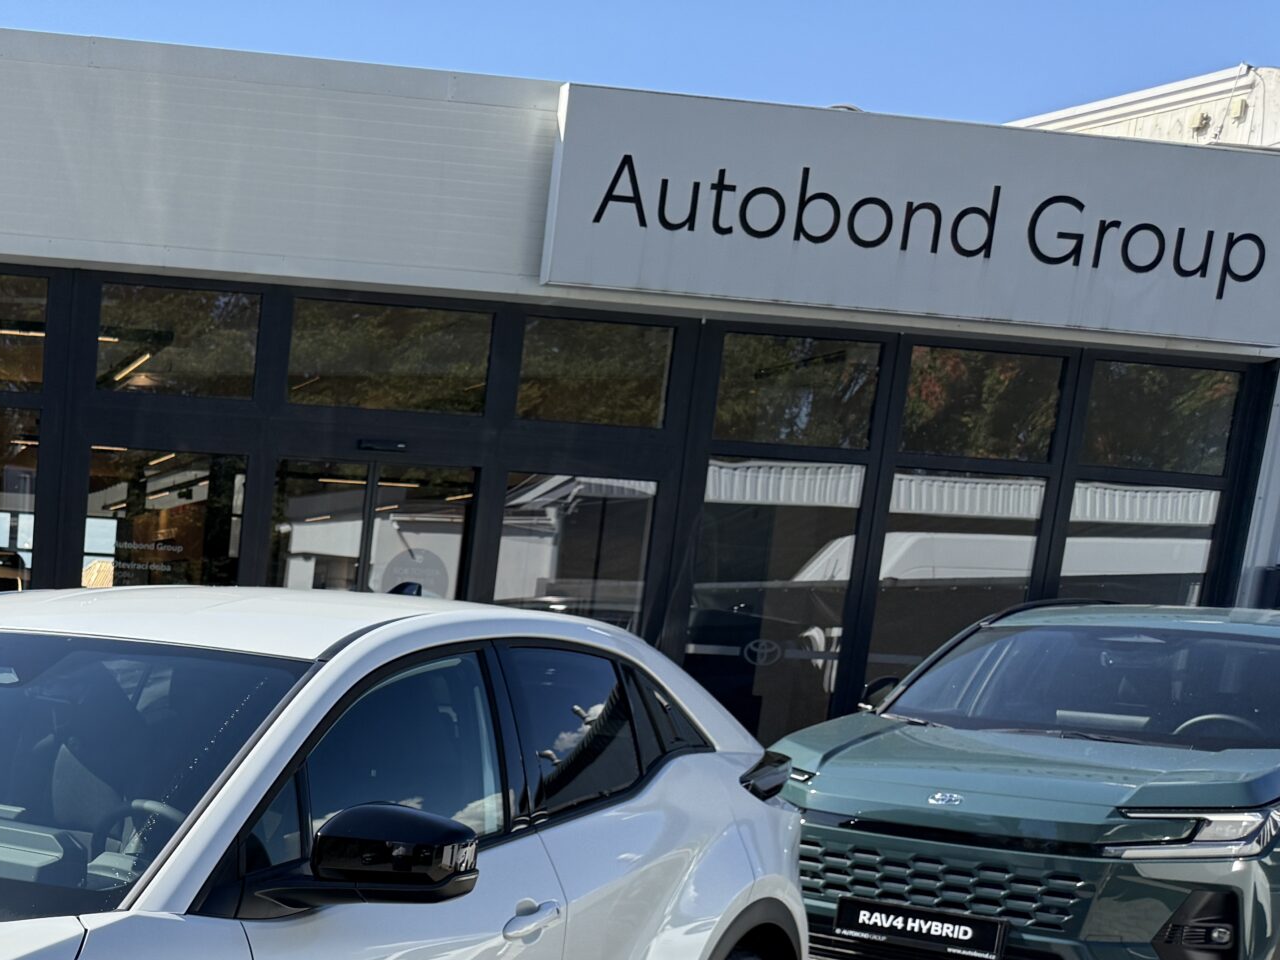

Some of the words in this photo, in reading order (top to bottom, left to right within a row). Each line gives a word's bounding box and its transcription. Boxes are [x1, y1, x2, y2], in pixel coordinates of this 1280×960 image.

[592, 153, 1002, 259] Autobond
[1027, 195, 1266, 300] Group
[156, 543, 183, 553] Group
[858, 910, 904, 930] RAV4
[906, 917, 973, 941] HYBRID
